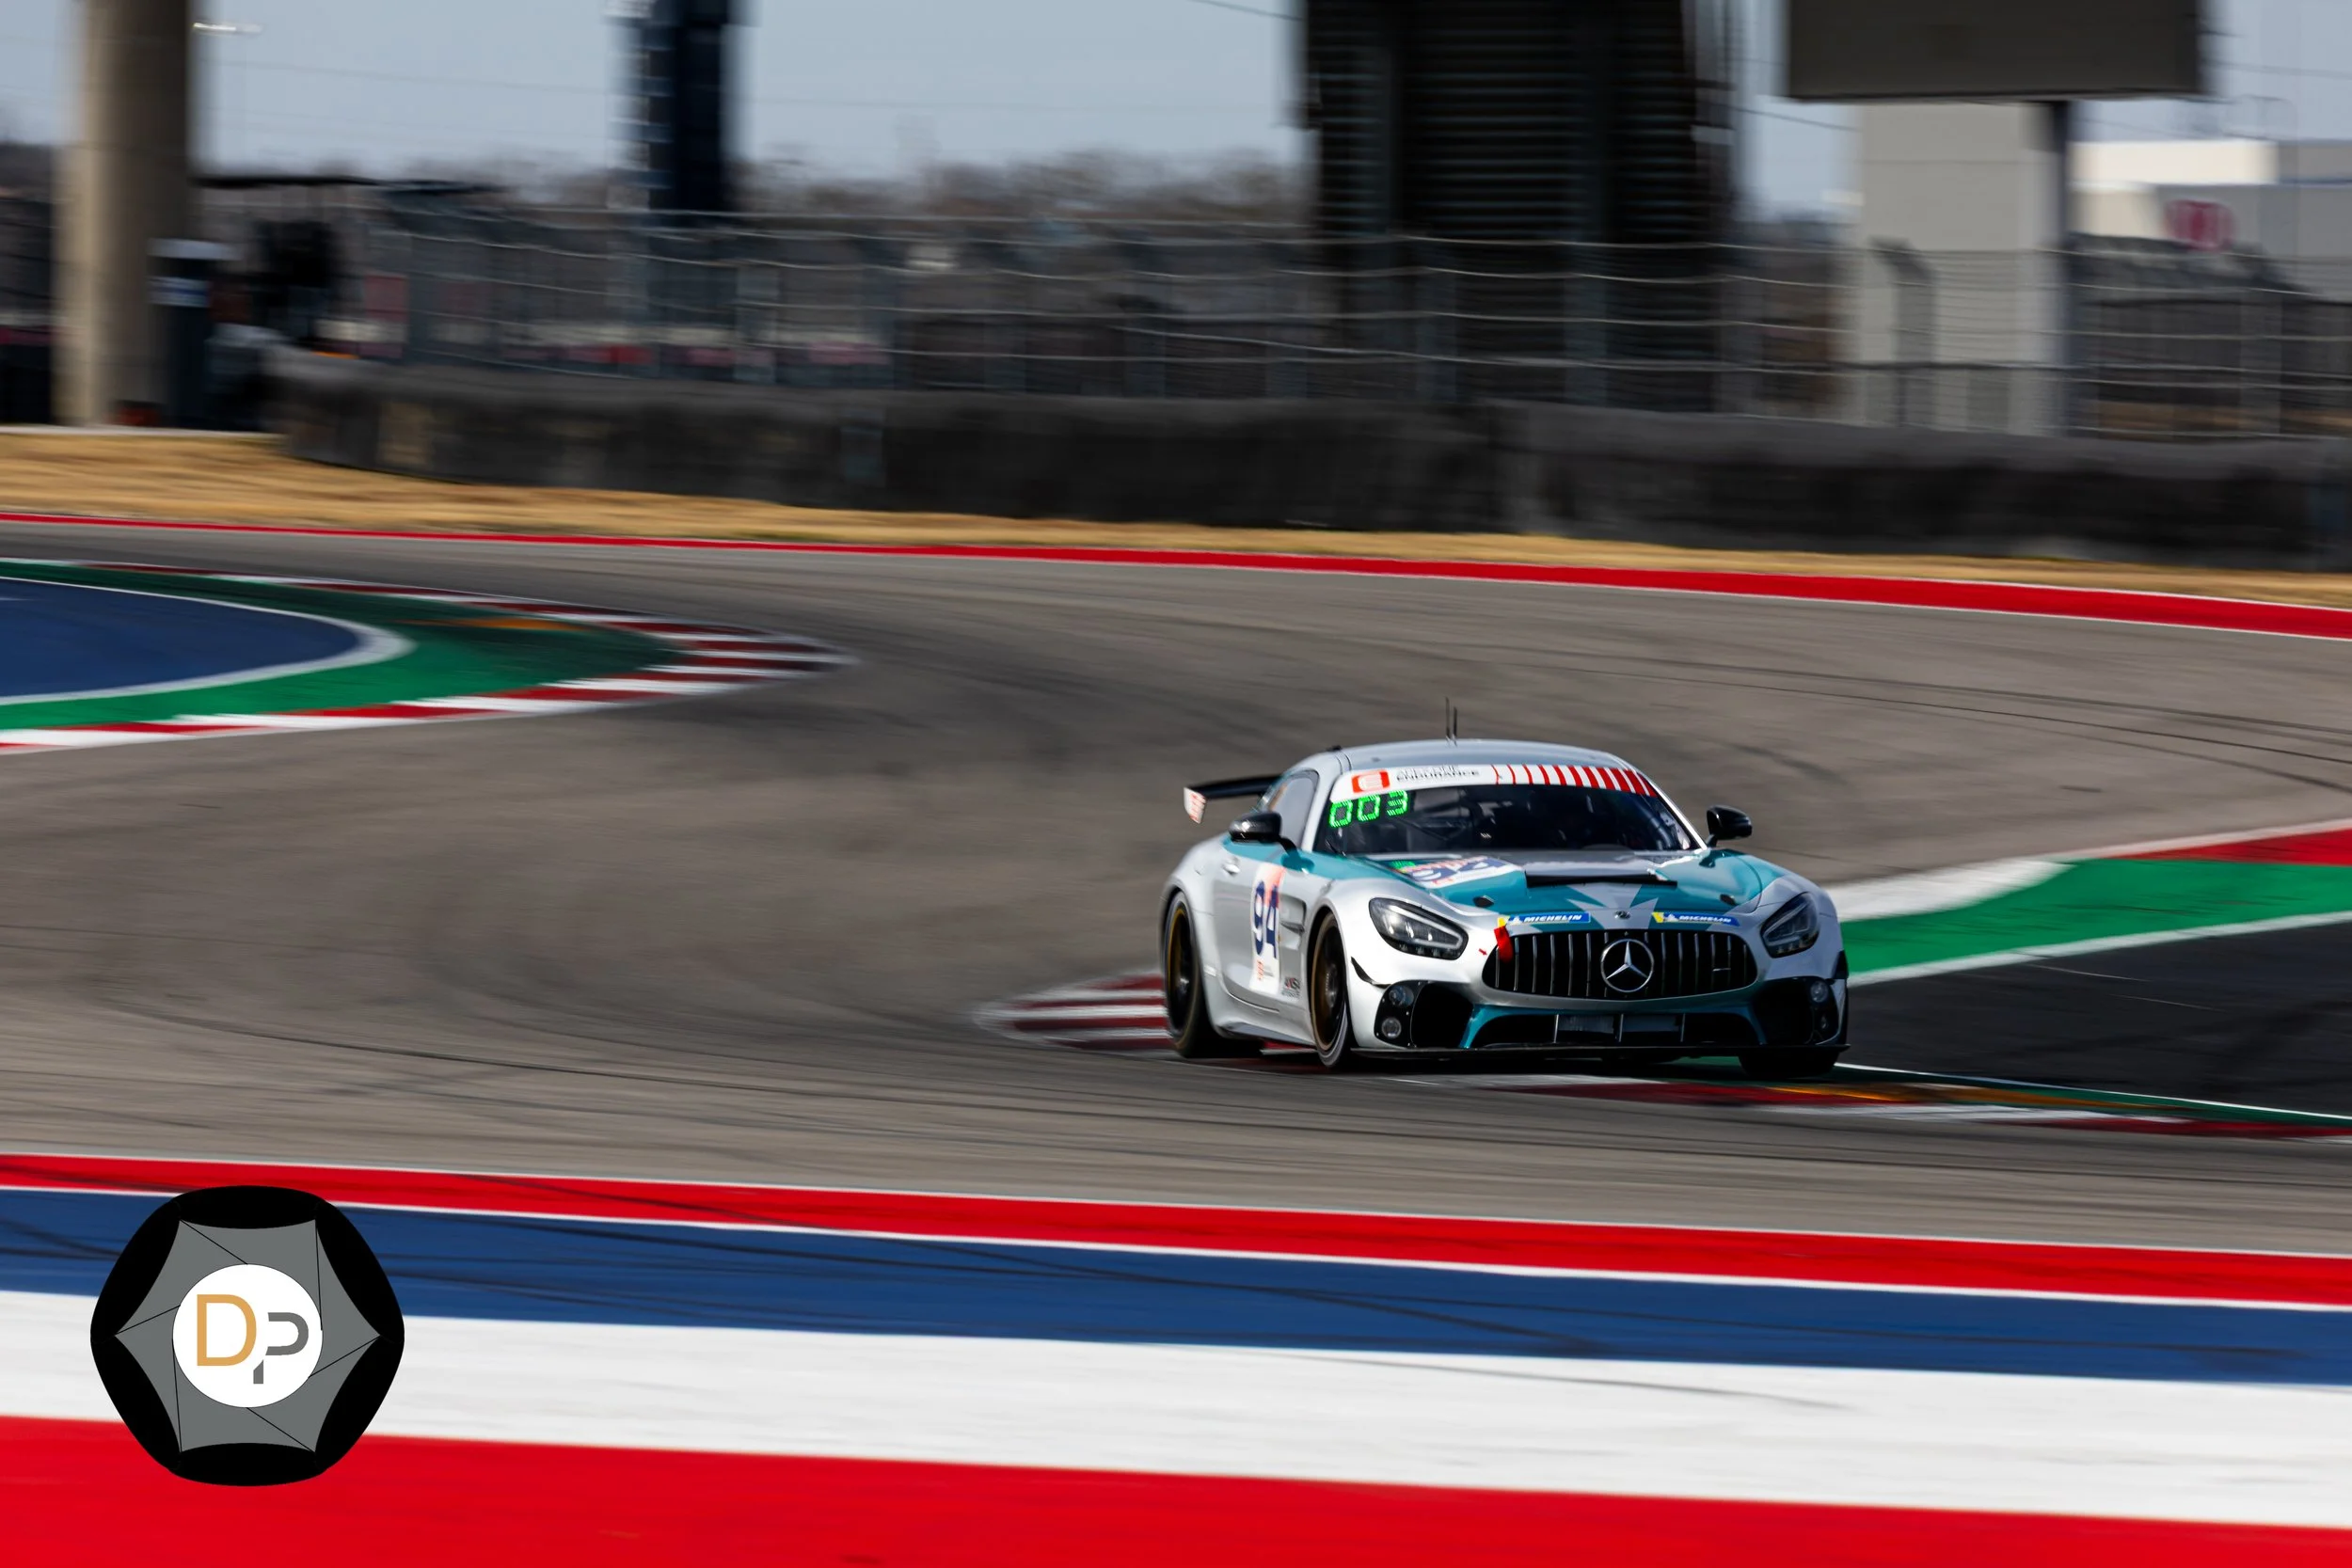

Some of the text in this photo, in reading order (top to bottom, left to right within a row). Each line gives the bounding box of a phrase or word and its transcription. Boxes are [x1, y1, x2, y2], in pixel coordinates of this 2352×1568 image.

[1328, 790, 1408, 828] 003
[1254, 880, 1279, 958] 94
[1524, 914, 1581, 923] MICHELIN
[1679, 915, 1732, 924] MICHELIN
